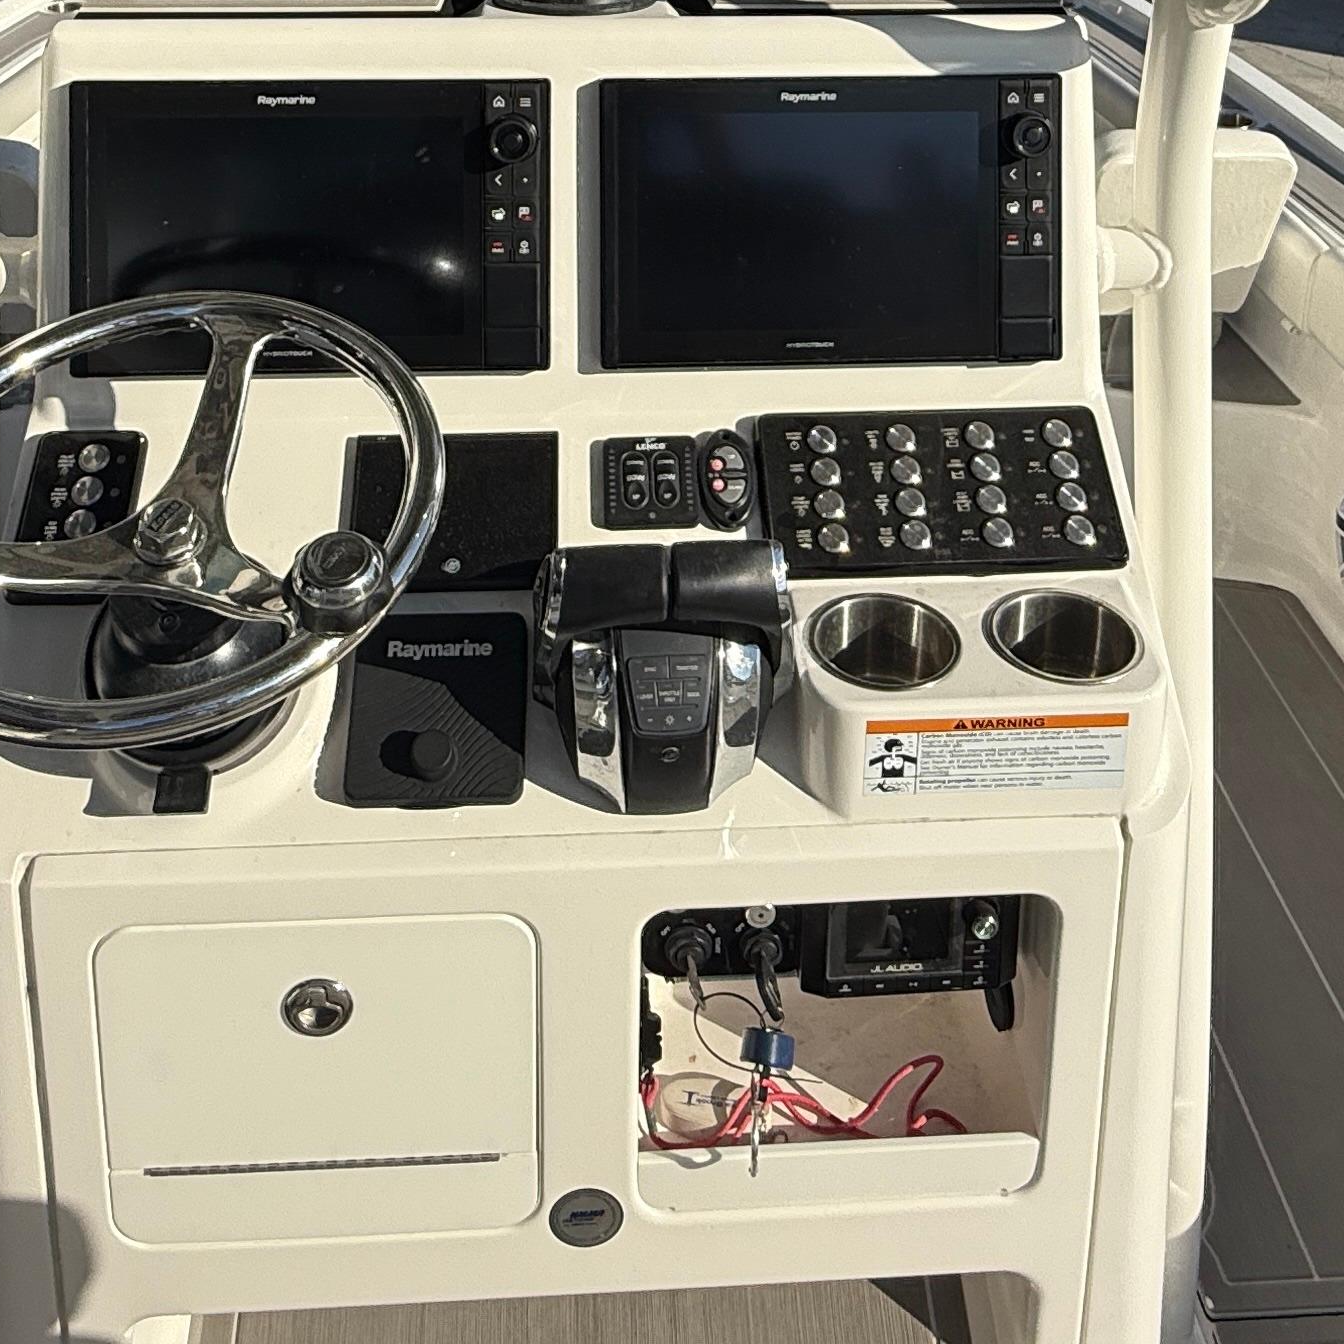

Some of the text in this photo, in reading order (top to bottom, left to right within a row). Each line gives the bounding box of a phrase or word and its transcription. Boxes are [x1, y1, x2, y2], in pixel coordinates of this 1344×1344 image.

[257, 95, 316, 108] Raymarine
[780, 92, 837, 104] Raymarine
[386, 640, 493, 662] Raymarine
[970, 718, 1045, 729] WARNING
[886, 962, 923, 972] AUDIO
